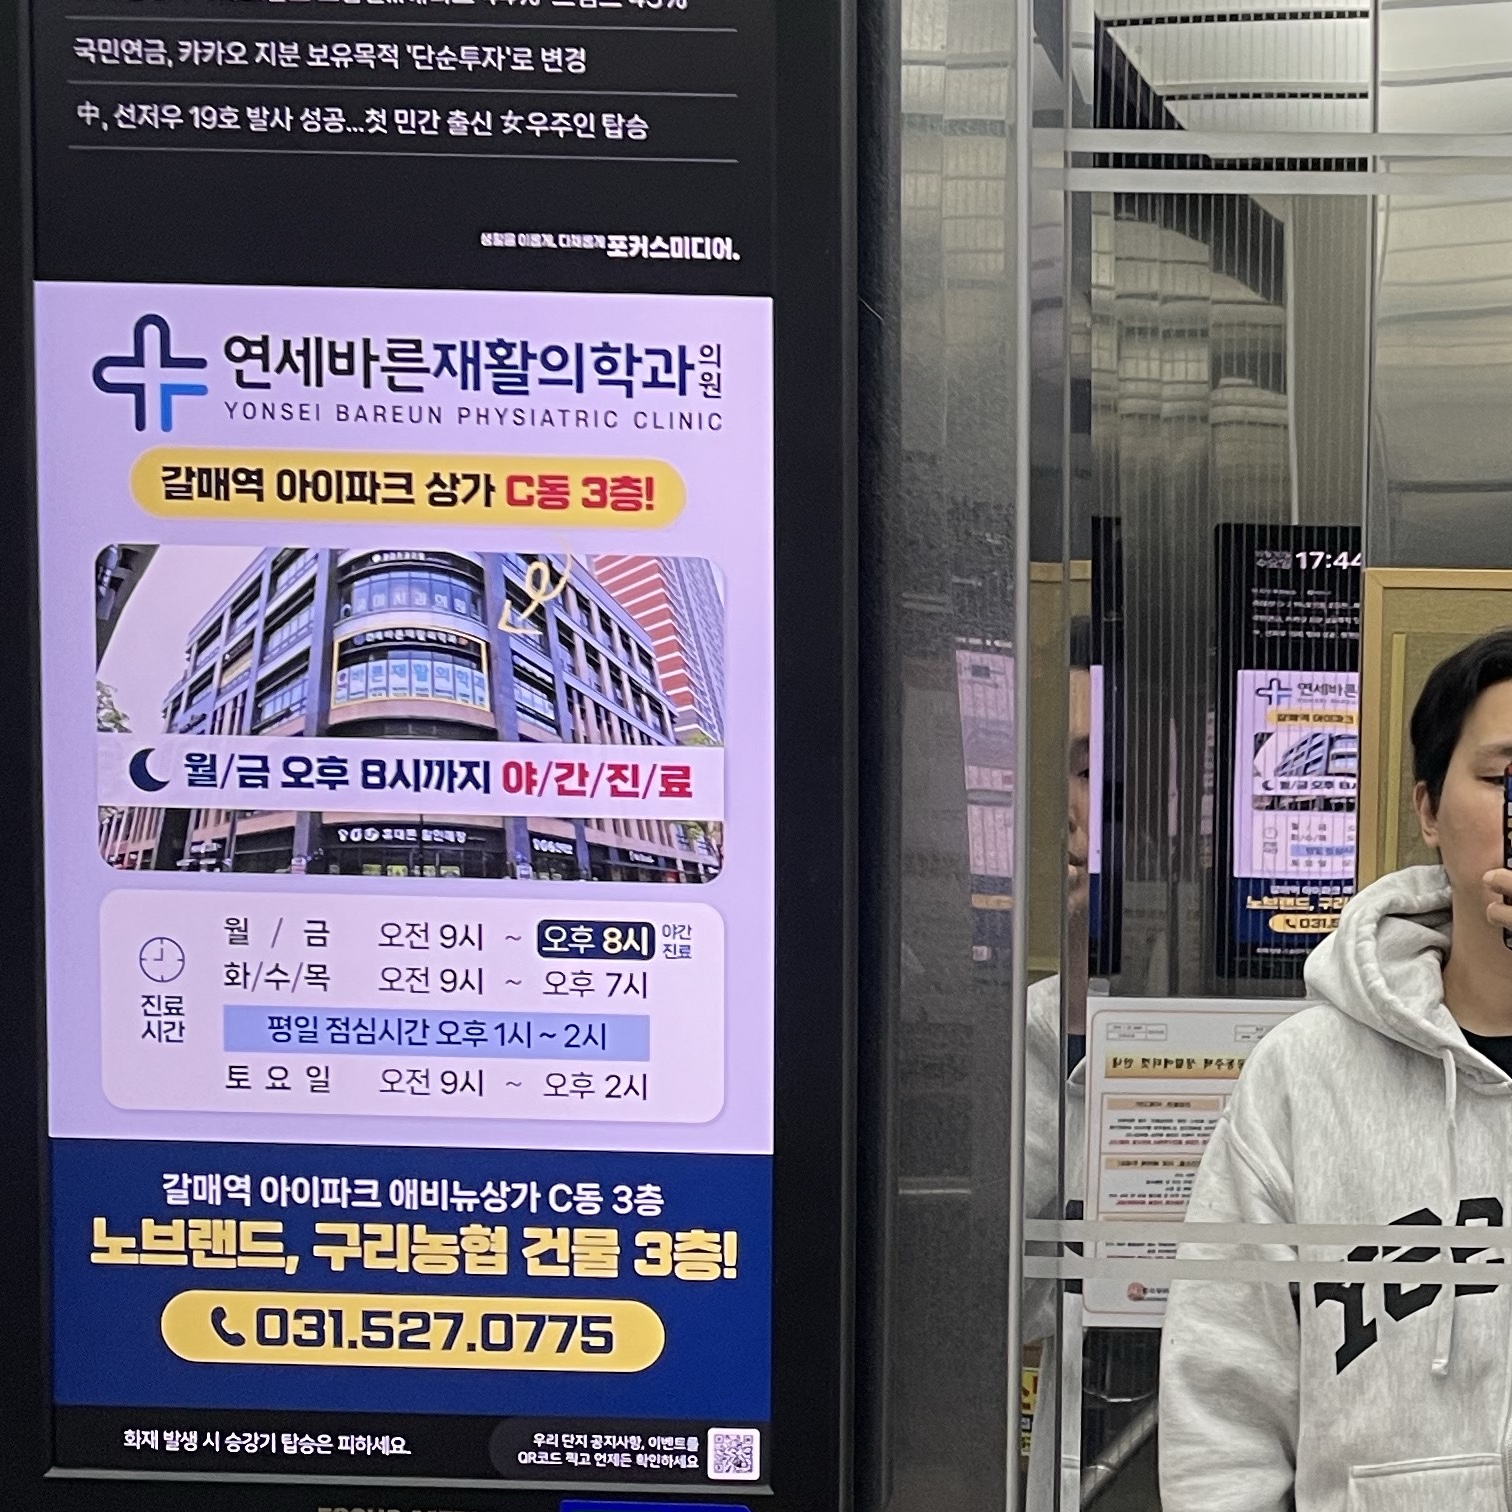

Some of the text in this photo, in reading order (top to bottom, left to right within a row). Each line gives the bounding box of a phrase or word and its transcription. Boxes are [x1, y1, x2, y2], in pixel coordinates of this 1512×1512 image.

[74, 39, 586, 74] 국민연금, 카카오 지분 보유목적 '단순투자'로 변경
[114, 103, 183, 131] 선저우
[189, 104, 241, 131] 19호
[246, 106, 293, 132] 발사
[394, 109, 441, 136] 민간
[447, 111, 493, 137] 출신
[601, 112, 649, 139] 탑승
[607, 235, 740, 261] 포커스미디어.
[223, 334, 696, 398] 연세바른재활의학과
[224, 401, 723, 431] YONSEI BAREUN PHYSIATRIC CLINIC
[161, 465, 654, 512] 갈매역 아이파크 상가 C동 3층!
[183, 751, 693, 800] 월/금 오후 8시까지 야/간/진/료
[224, 918, 249, 945] 월
[304, 920, 331, 947] 금
[378, 922, 431, 950] 오전
[440, 923, 484, 951] 9시
[542, 925, 594, 955] 오후
[602, 927, 649, 955] 8시
[662, 924, 692, 942] 야간
[662, 944, 693, 959] 진료
[223, 962, 331, 991] 화/수/목
[379, 967, 431, 995] 오전
[440, 968, 484, 996] 9시
[543, 971, 594, 999] 오후
[605, 972, 648, 999] 7시
[141, 995, 184, 1018] 진료
[141, 1020, 185, 1045] 시간
[268, 1016, 319, 1045] 평일
[325, 1018, 430, 1048] 점심시간
[435, 1020, 489, 1048] 오후
[494, 1022, 532, 1049] 1시
[563, 1023, 607, 1050] 2시
[225, 1065, 252, 1091] 토
[266, 1067, 291, 1092] 요
[307, 1066, 331, 1093] 일
[379, 1068, 431, 1097] 오전
[440, 1069, 484, 1098] 9시
[544, 1072, 594, 1100] 오후
[604, 1073, 648, 1101] 2시
[163, 1173, 665, 1217] 갈매역 아이파크 애비뉴상가 C동 3층
[90, 1217, 738, 1280] 노브랜드, 구리농협 건물 3층!
[255, 1307, 614, 1354] 031.527.0775
[124, 1429, 411, 1455] 화재 발생 시 승강기 탑승은 피하세요.
[533, 1433, 559, 1447] 우리
[561, 1434, 588, 1448] 단지
[590, 1435, 644, 1450] 공지사항,
[518, 1451, 699, 1469] QR코드 찍고 언제든 확인하세요
